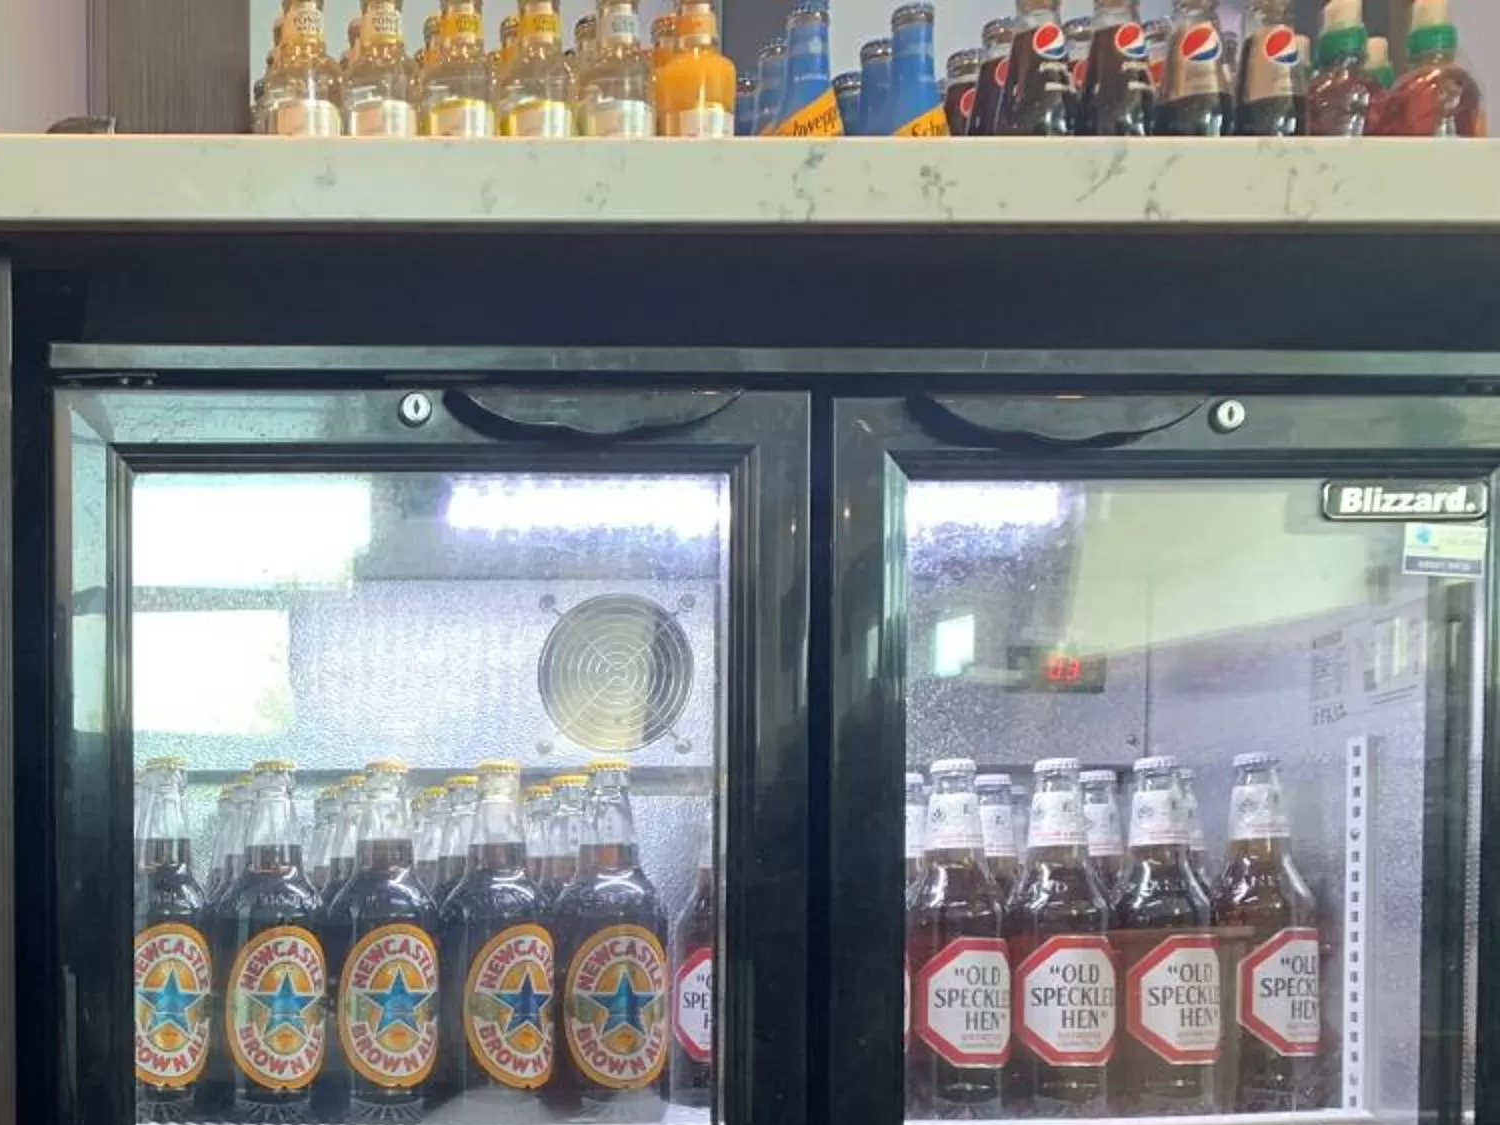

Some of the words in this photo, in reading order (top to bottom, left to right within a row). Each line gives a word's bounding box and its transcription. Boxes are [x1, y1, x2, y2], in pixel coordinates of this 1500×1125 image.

[576, 940, 664, 991] NEWCASTLE
[933, 987, 1010, 1008] SPECKLE
[1147, 986, 1220, 1007] SPECKLE
[576, 1026, 647, 1075] BROWN
